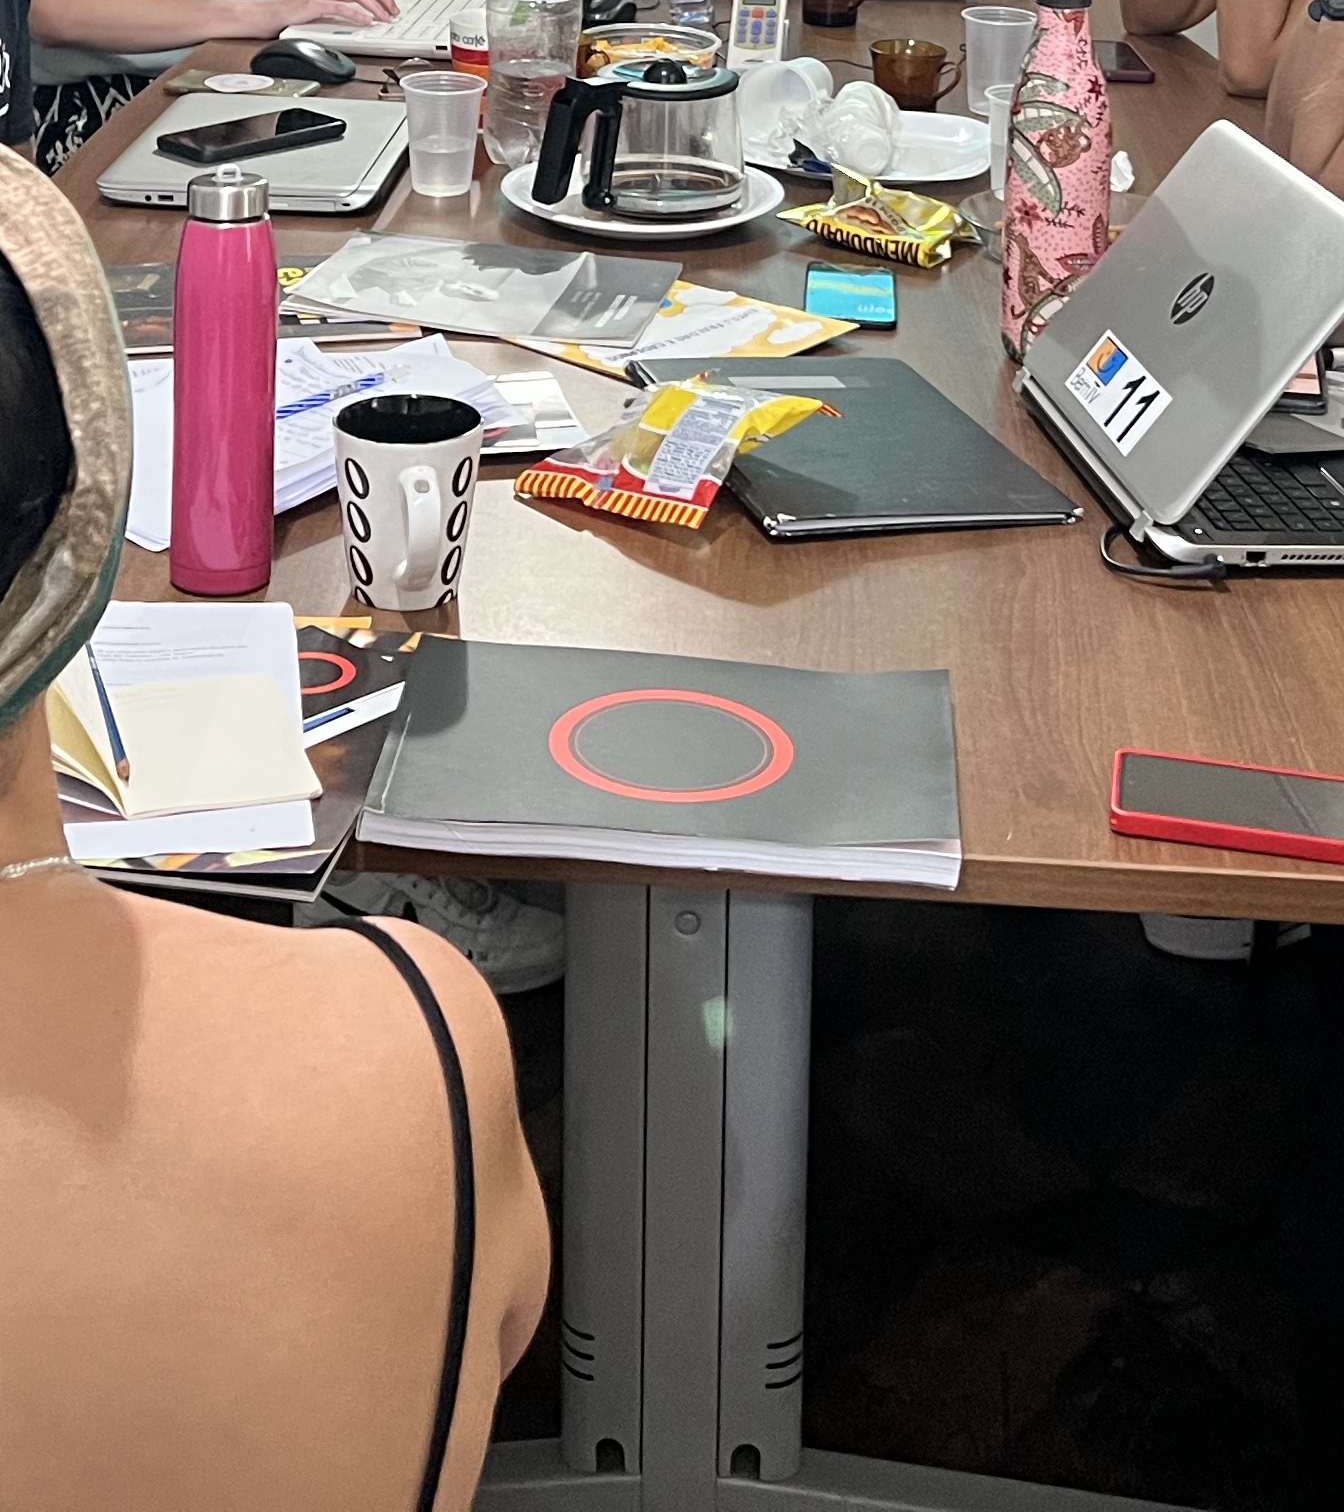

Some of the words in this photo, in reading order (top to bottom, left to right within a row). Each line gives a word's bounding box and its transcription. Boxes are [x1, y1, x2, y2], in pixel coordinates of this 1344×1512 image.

[462, 33, 486, 48] café
[1170, 272, 1215, 325] hp
[1103, 375, 1160, 444] 11
